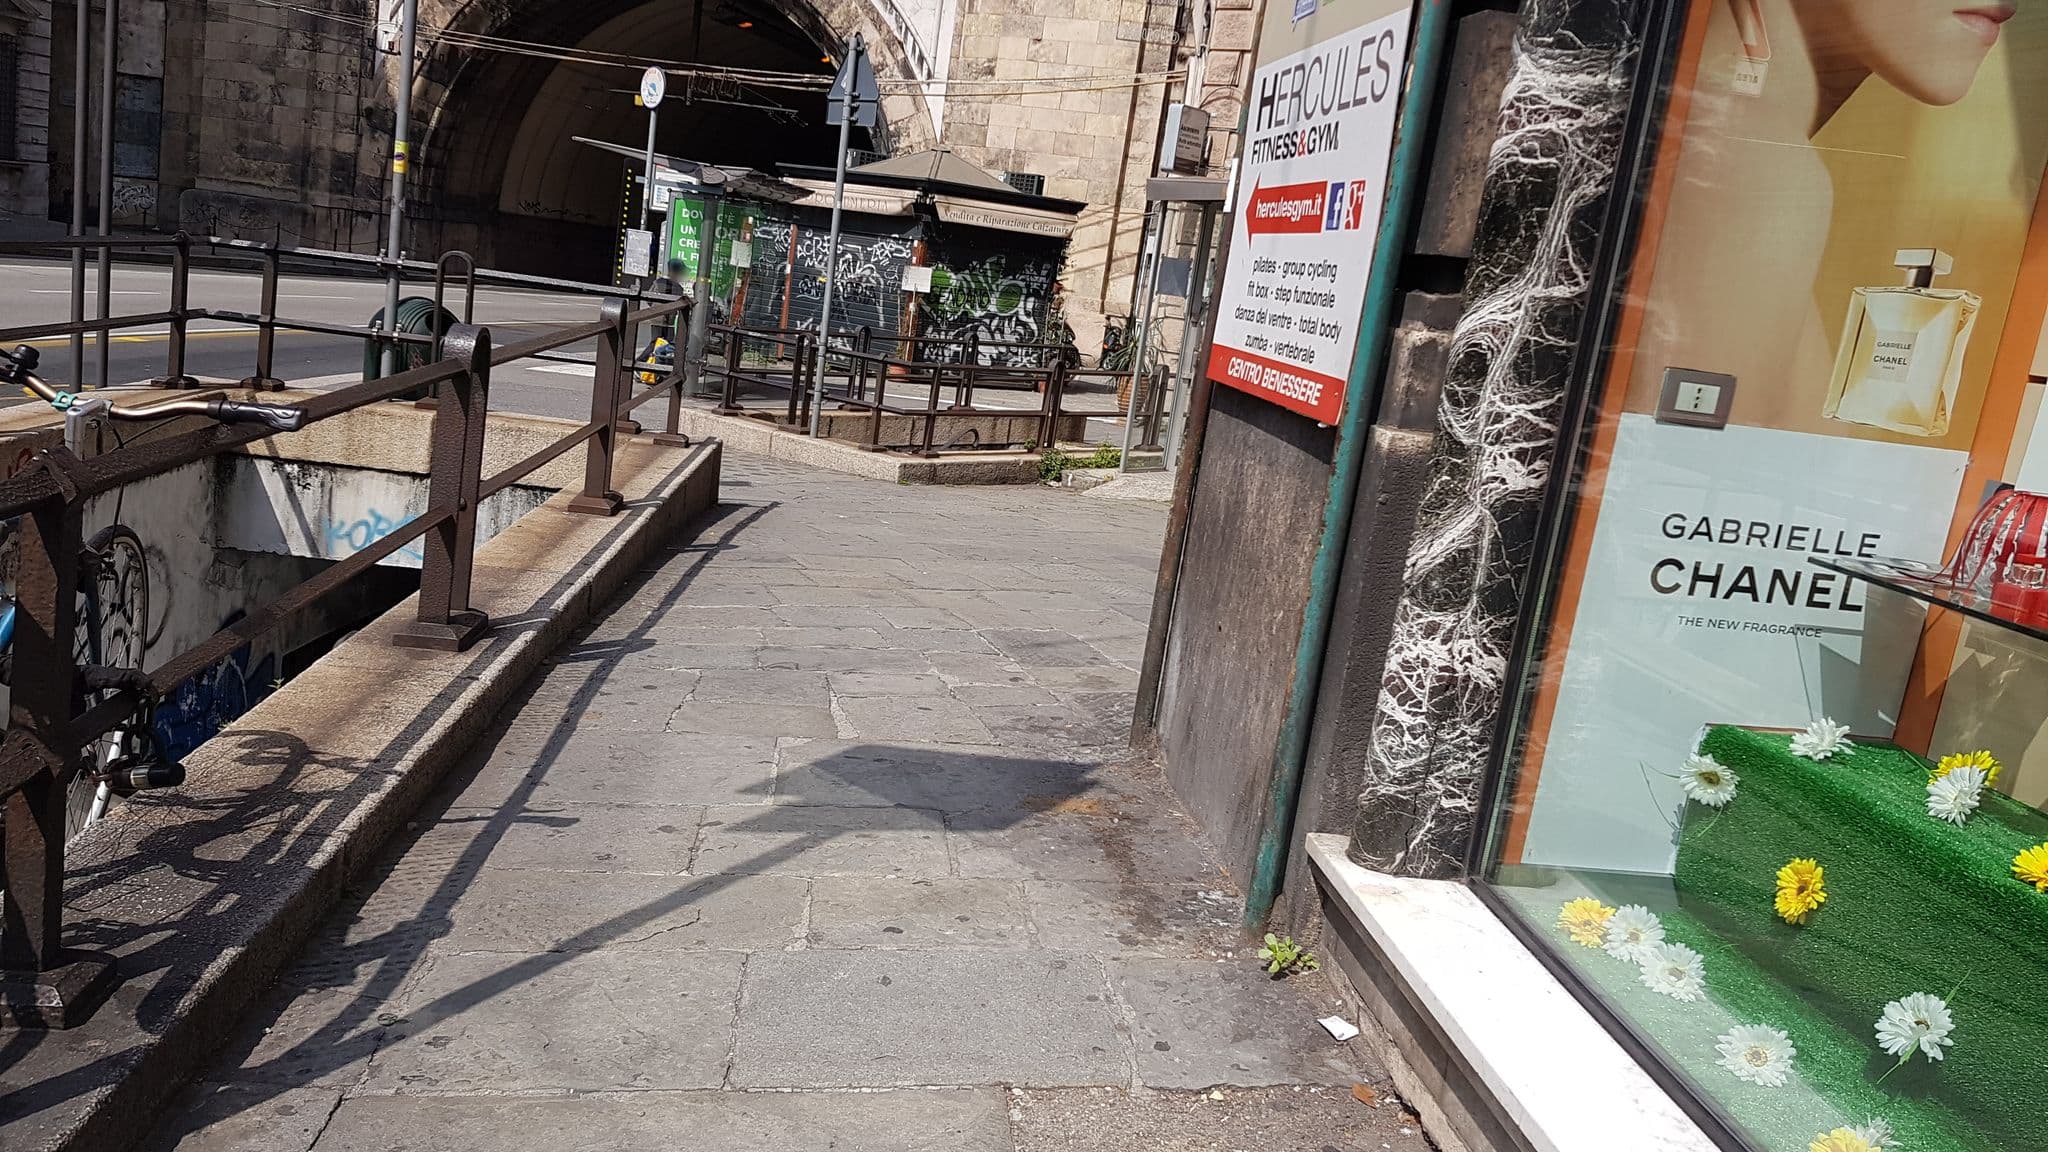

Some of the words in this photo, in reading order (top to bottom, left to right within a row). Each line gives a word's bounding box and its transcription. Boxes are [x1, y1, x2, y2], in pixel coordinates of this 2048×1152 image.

[1256, 29, 1394, 132] HERCULES
[944, 209, 974, 221] Vendita
[982, 214, 1031, 229] Riparazione
[1032, 221, 1069, 234] Calzature
[1256, 194, 1322, 222] herculesgym.it
[1252, 256, 1276, 275] pilates
[1283, 261, 1305, 280] group
[1307, 259, 1337, 283] cycling
[1247, 280, 1255, 297] fit
[1255, 281, 1269, 299] box
[1275, 284, 1292, 305] step
[1293, 285, 1335, 308] funzionale
[1235, 304, 1255, 322] danza
[1256, 307, 1268, 325] del
[1268, 312, 1292, 330] ventre
[1298, 315, 1319, 335] total
[1319, 318, 1342, 344] body
[1245, 334, 1268, 351] zumba
[1274, 340, 1315, 364] vertebrale
[1877, 341, 1912, 350] GABRIELLE
[1873, 355, 1907, 366] CHANEL
[1227, 357, 1262, 384] CENTRO
[1261, 366, 1324, 406] BENESSERE
[1662, 512, 1881, 558] GABRIELLE
[1650, 557, 1863, 612] CHANEL
[1678, 615, 1704, 628] THE
[1706, 618, 1741, 631] NEW
[1742, 622, 1823, 639] FRAGRANCE
